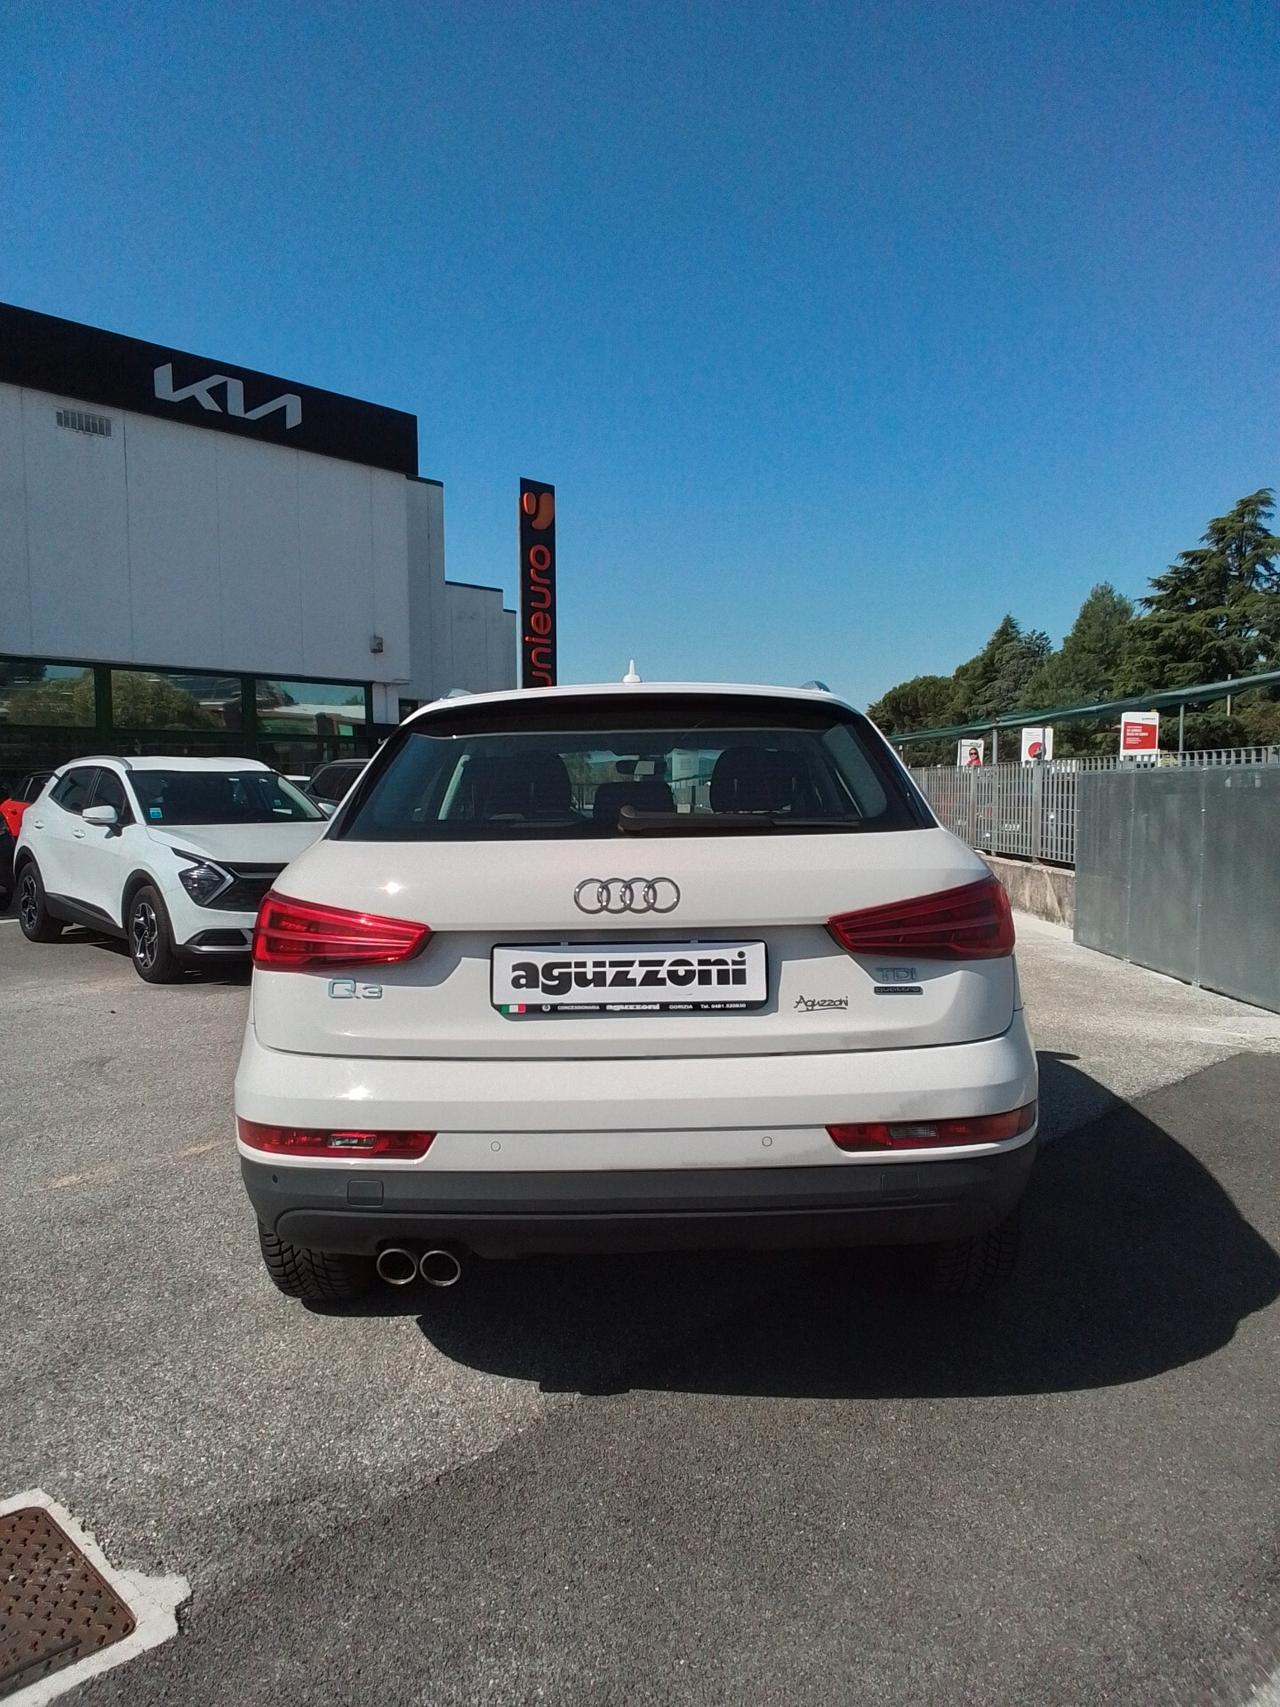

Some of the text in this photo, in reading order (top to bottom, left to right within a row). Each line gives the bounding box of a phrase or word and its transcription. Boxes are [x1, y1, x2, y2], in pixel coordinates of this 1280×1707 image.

[525, 544, 552, 688] unieuro
[511, 951, 747, 996] aguzzoni
[875, 967, 917, 981] TDI
[328, 978, 383, 999] Q3
[793, 995, 849, 1011] Aguzzoni
